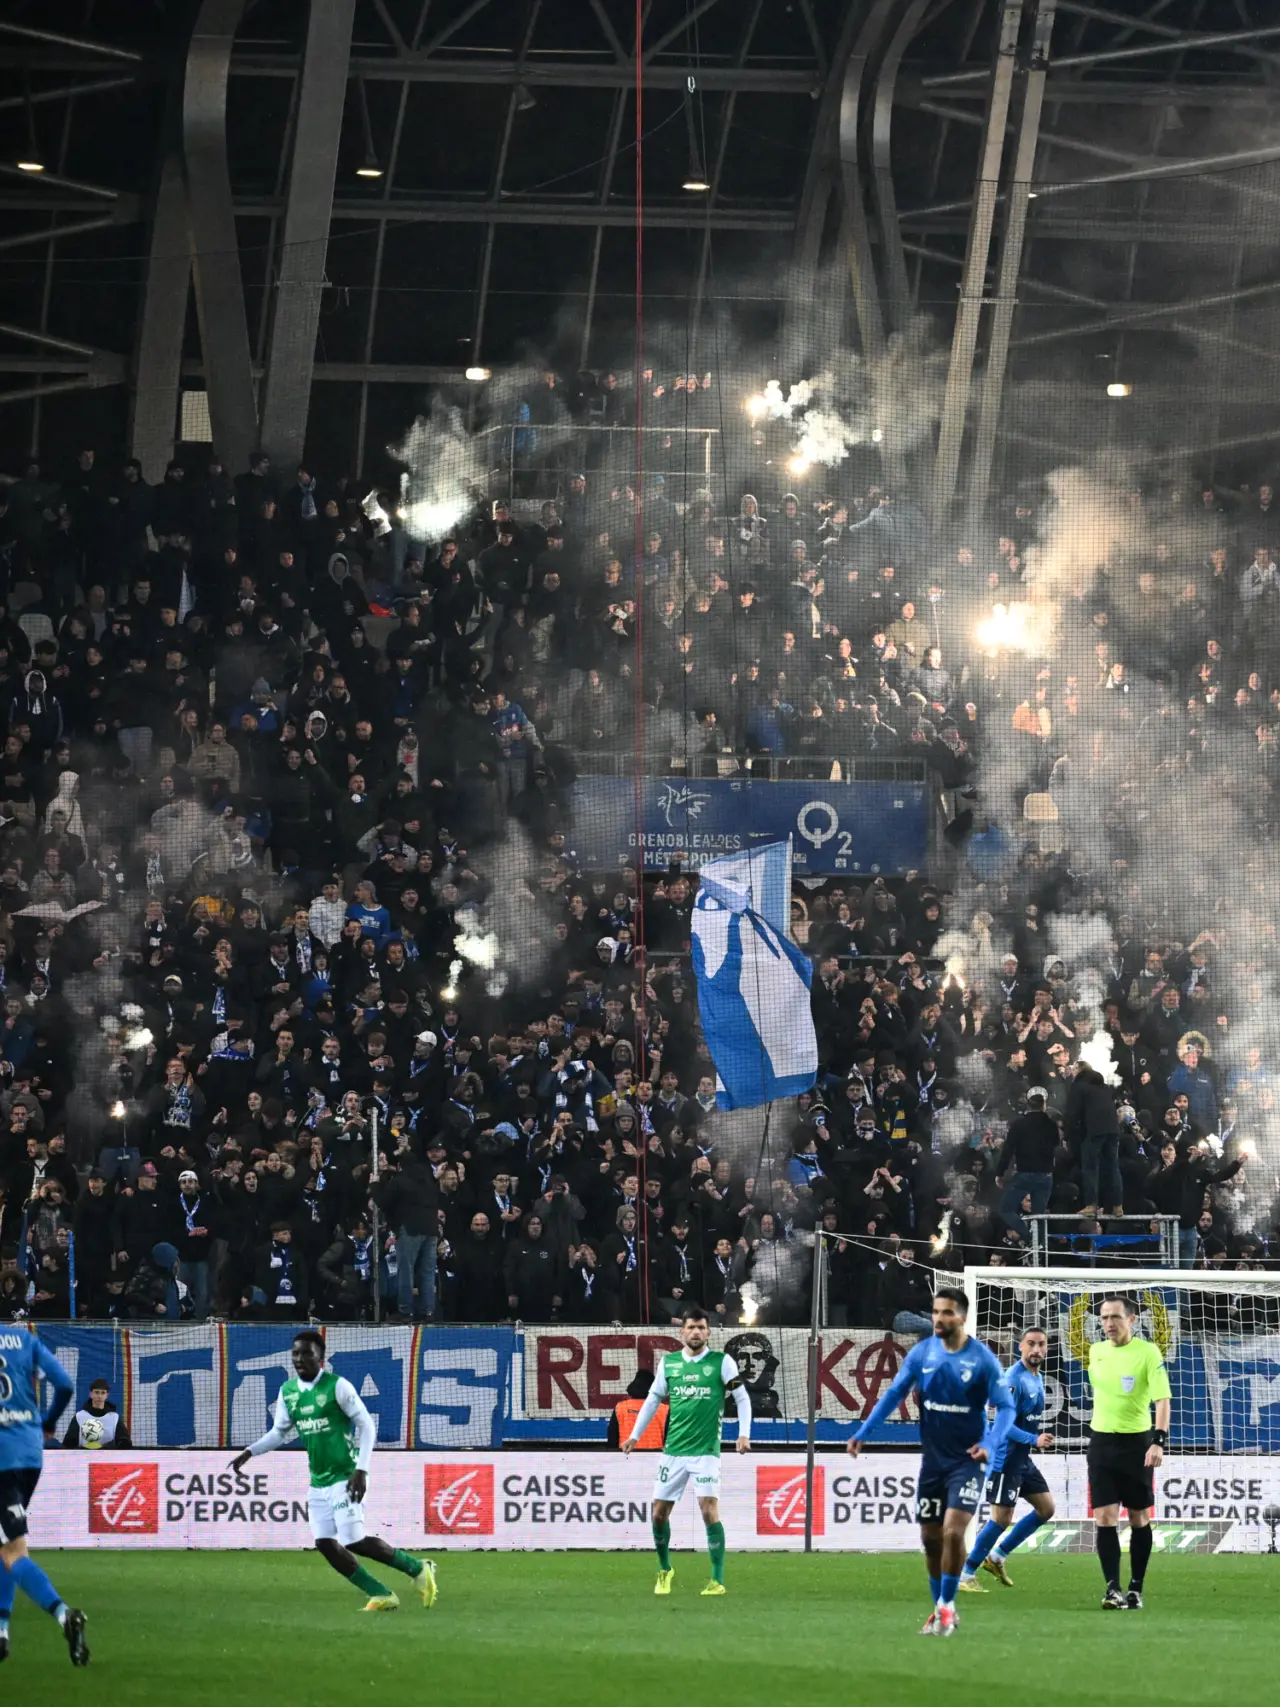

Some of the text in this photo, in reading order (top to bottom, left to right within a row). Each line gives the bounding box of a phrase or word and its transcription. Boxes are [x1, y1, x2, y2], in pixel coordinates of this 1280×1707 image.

[165, 1473, 269, 1497] CAISSE
[502, 1475, 605, 1497] CAISSE
[832, 1476, 916, 1498] CAISS
[1162, 1478, 1263, 1500] CAISSE
[166, 1500, 308, 1523] D'EPARGN
[504, 1501, 654, 1523] D'EPARGN
[920, 1498, 941, 1518] 27
